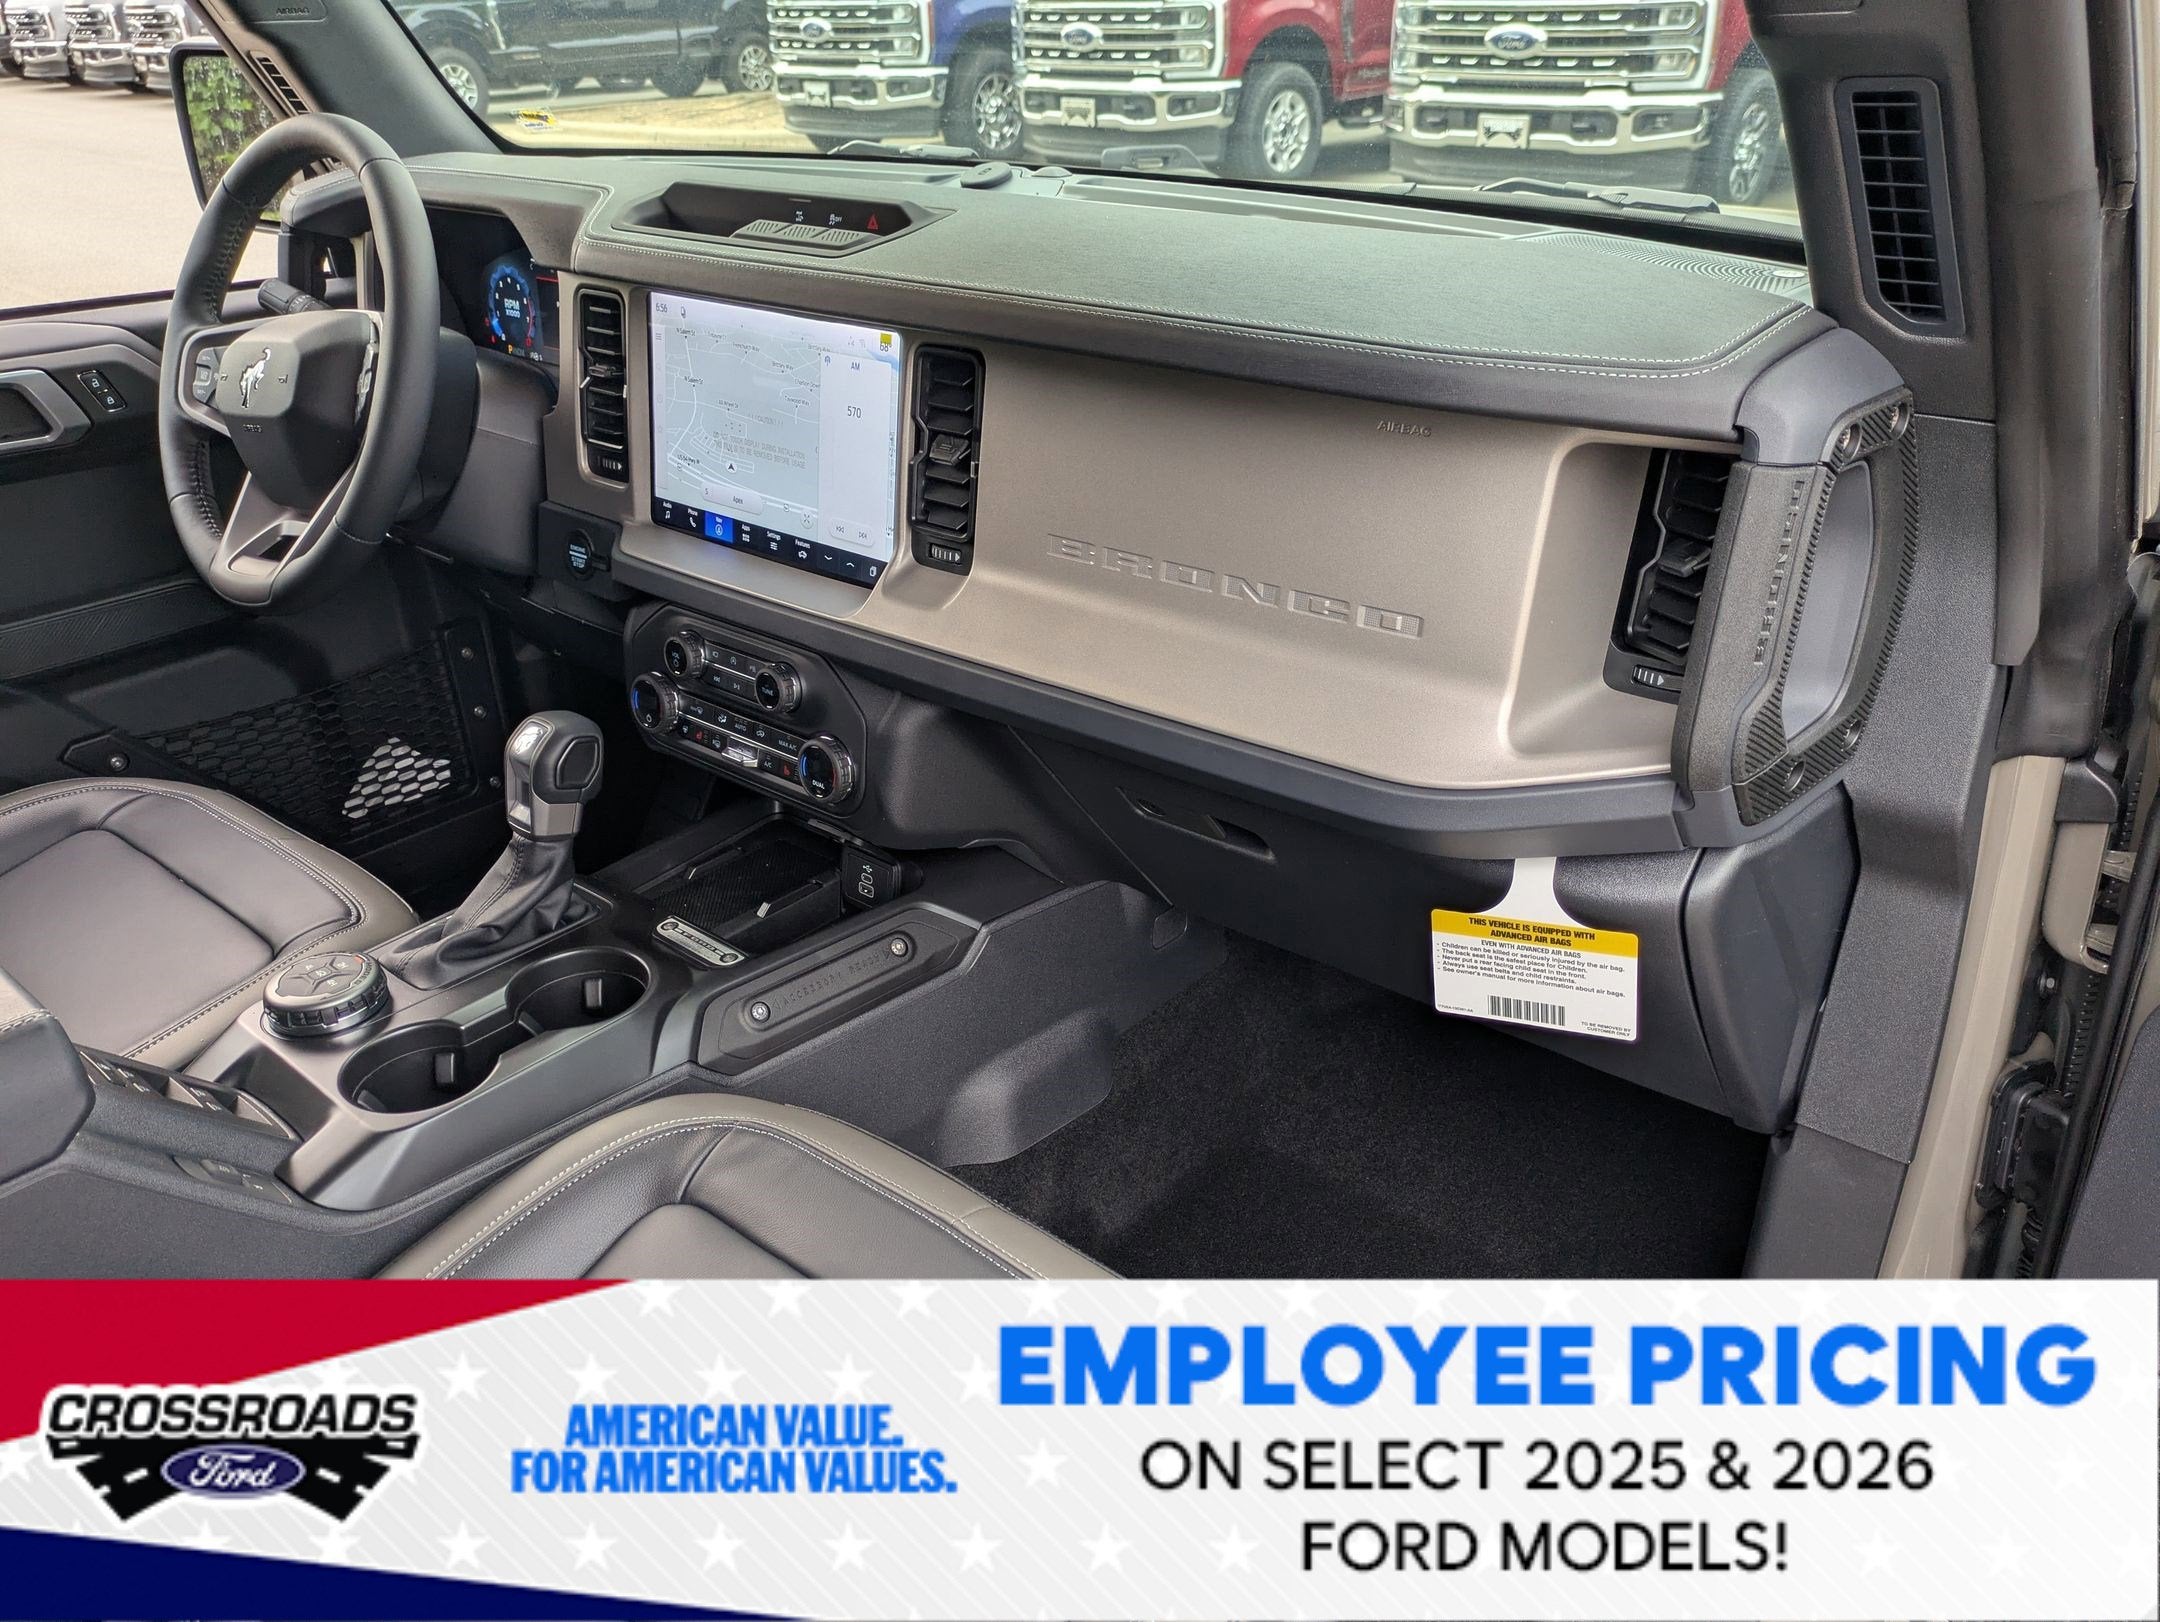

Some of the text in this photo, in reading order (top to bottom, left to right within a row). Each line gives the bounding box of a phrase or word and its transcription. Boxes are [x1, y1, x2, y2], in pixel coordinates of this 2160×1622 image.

[504, 298, 520, 311] RPM
[655, 302, 668, 313] 6:56
[850, 361, 860, 370] AM
[847, 405, 862, 418] 570
[1377, 420, 1432, 437] AIRBAG
[1046, 533, 1424, 639] BRONCO
[734, 723, 747, 732] AUTO
[778, 740, 797, 751] MAX A/C
[763, 760, 772, 769] A/C
[812, 780, 825, 790] DUAL
[1469, 917, 1595, 940] THIS VEHICLE IS EQUIPPED WITH
[1491, 930, 1571, 946] ADVANCED AIR BAGS
[1499, 942, 1514, 950] WITH
[1517, 944, 1549, 954] ADVANCED
[1564, 950, 1581, 958] BAGS
[1442, 942, 1468, 950] Children
[1520, 953, 1550, 962] seriously
[1552, 957, 1575, 965] injured
[1610, 965, 1624, 973] bag.
[1443, 961, 1465, 969] Always
[1543, 975, 1576, 984] restraints.
[1494, 962, 1513, 970] facing
[1528, 960, 1545, 968] place
[1558, 964, 1587, 973] Children.
[1456, 968, 1480, 976] owner's
[1482, 972, 1505, 980] manual
[1536, 980, 1573, 990] information
[1607, 990, 1625, 998] bags.
